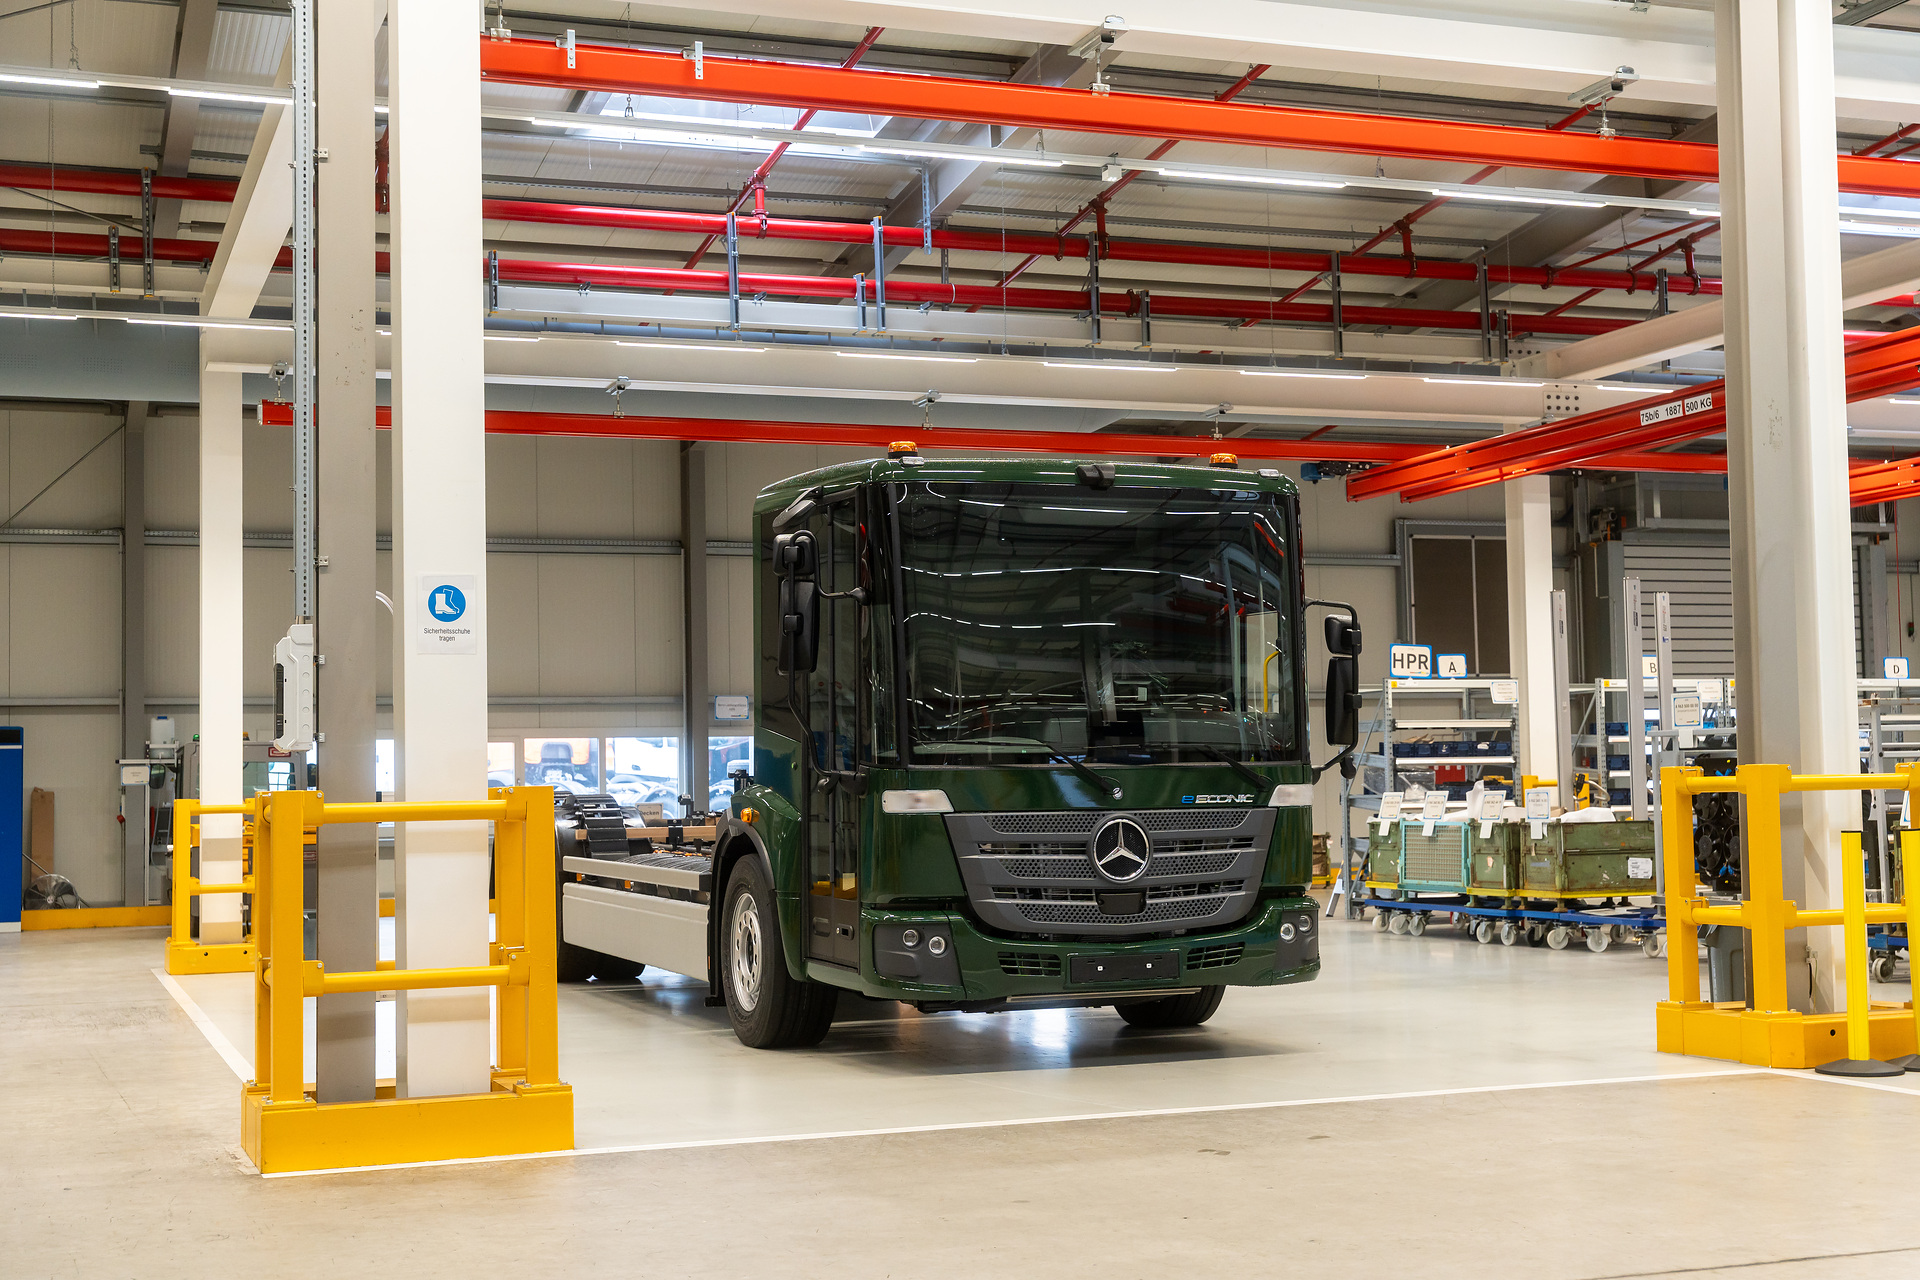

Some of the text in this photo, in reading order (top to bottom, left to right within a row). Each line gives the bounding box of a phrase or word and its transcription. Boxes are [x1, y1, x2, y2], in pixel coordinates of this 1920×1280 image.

[1686, 398, 1712, 412] 500 KG
[1641, 404, 1681, 422] 75b/6 1887
[423, 627, 470, 635] Sicherheitsschuhe
[1393, 653, 1428, 670] HPR
[1449, 661, 1457, 673] A
[1650, 662, 1657, 673] B
[1893, 664, 1900, 674] D
